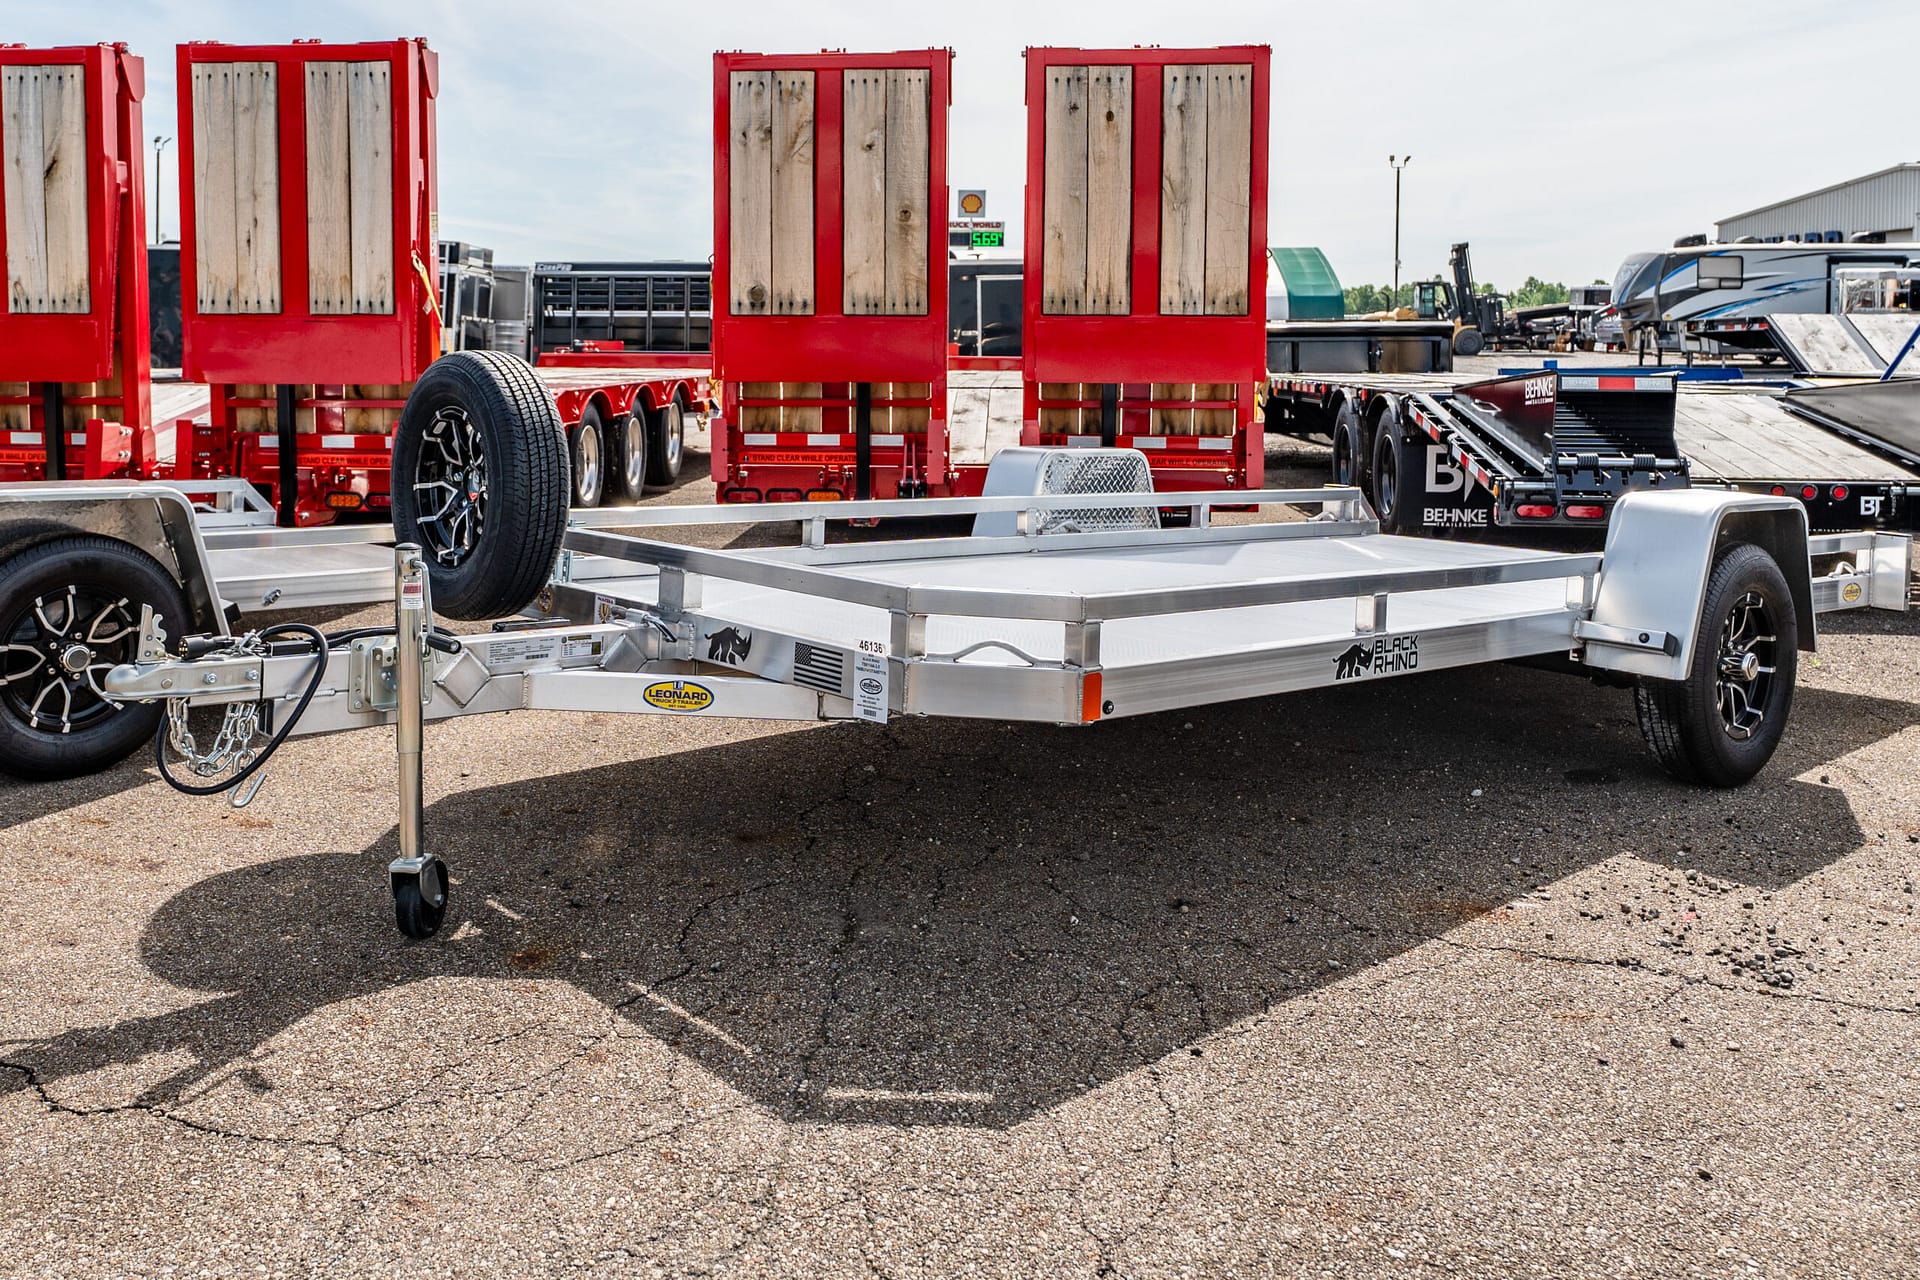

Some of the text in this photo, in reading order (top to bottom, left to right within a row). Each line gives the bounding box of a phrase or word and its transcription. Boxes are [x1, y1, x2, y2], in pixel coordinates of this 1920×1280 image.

[1525, 377, 1553, 400] BEHNKE
[346, 457, 368, 465] WHILE
[369, 457, 390, 465] OPER
[825, 455, 857, 463] OPERATI
[1151, 457, 1167, 465] EAR
[1425, 445, 1475, 503] B
[1860, 496, 1885, 517] BT
[1423, 508, 1488, 522] BEHNKE
[859, 640, 883, 654] 46136
[1374, 634, 1419, 655] BLACK
[1373, 651, 1418, 675] RHINO
[648, 689, 708, 701] LEONARD
